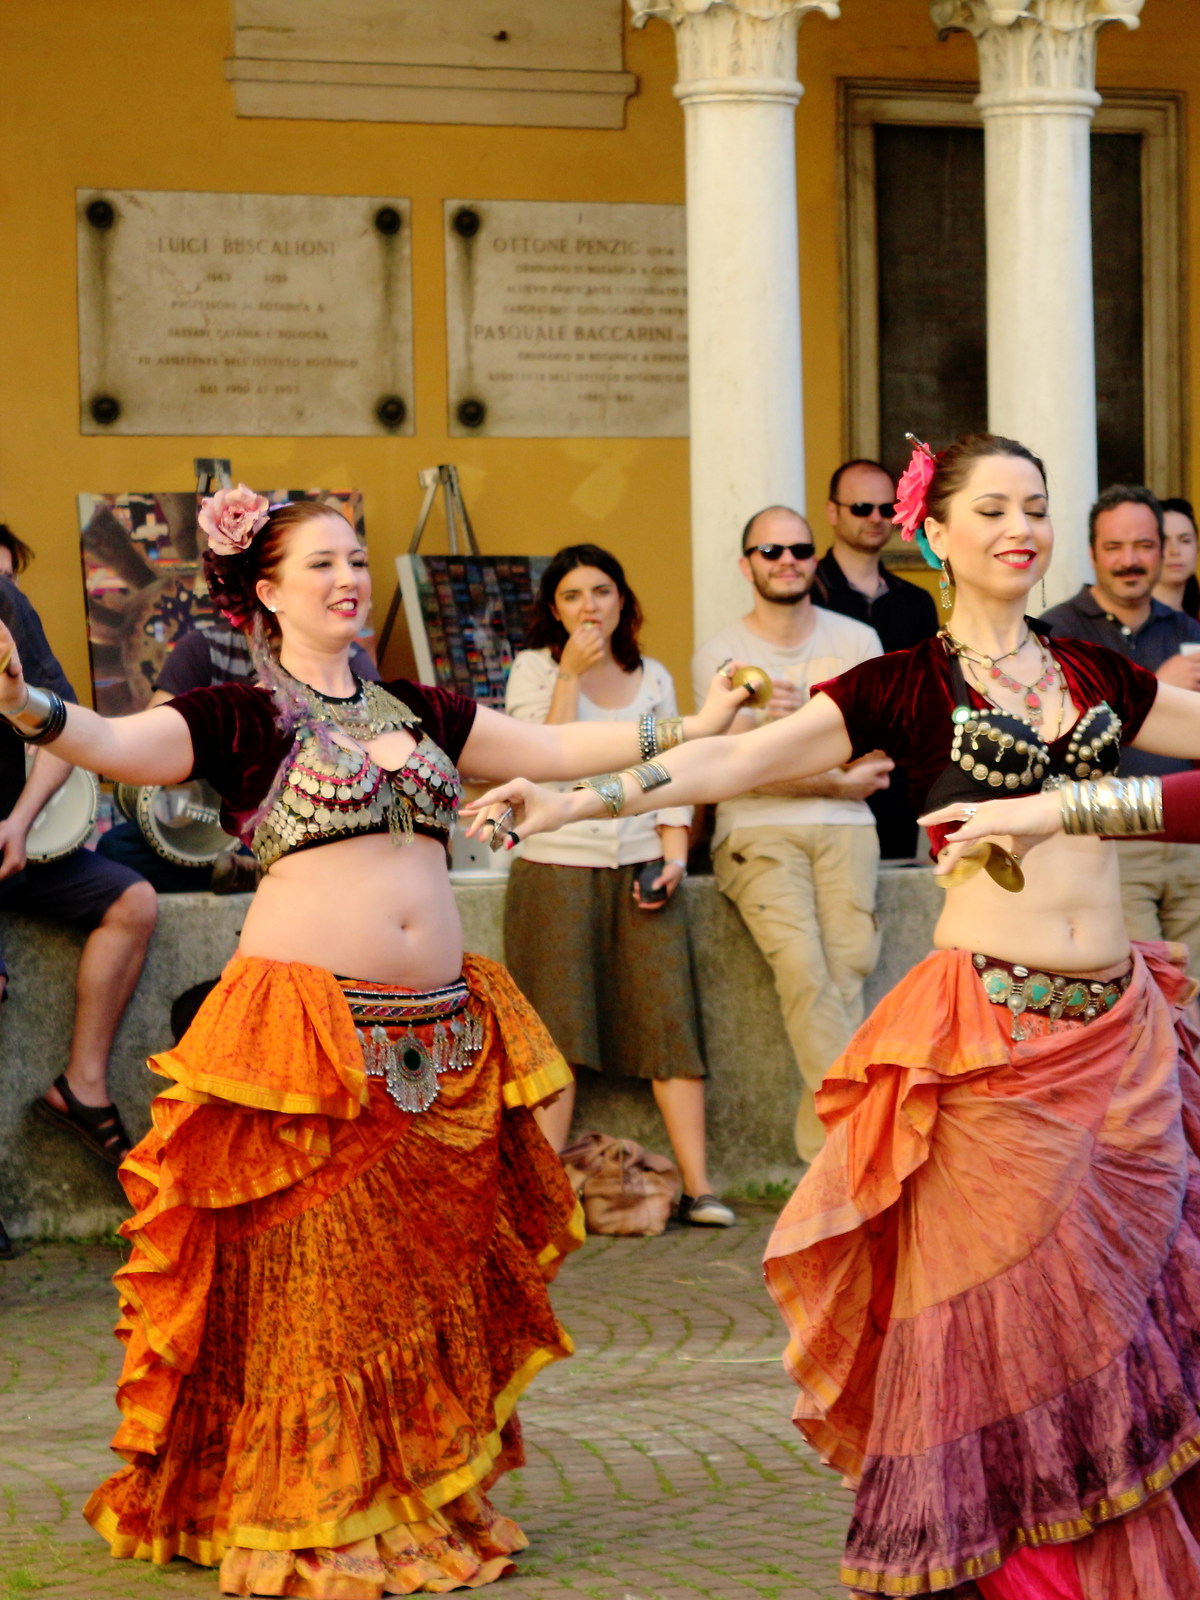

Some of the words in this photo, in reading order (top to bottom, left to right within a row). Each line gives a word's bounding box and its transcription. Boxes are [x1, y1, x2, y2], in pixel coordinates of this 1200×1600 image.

[493, 237, 569, 255] OTTONE
[474, 324, 567, 341] PASQUALE
[574, 325, 673, 343] BACCARINI
